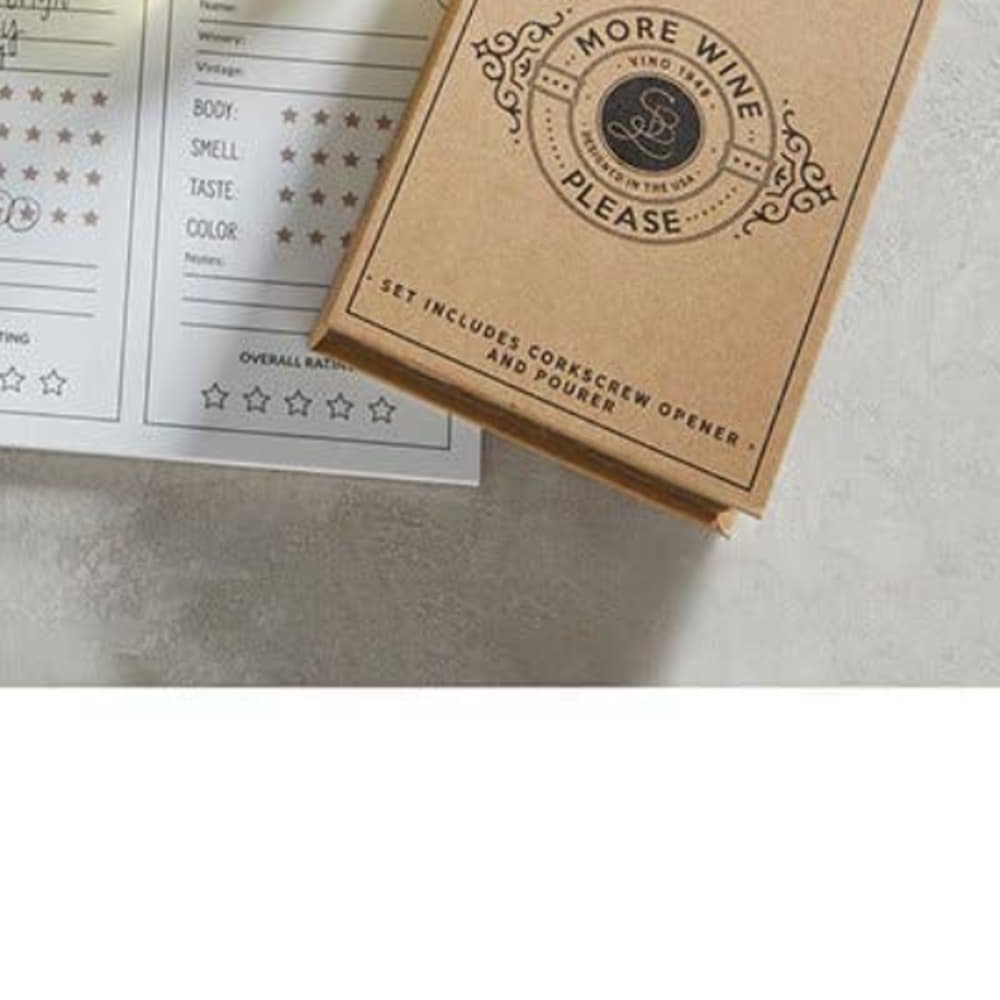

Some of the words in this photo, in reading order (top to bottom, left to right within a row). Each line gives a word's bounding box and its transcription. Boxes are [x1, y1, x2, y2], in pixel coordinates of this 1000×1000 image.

[576, 17, 679, 56] MORE
[696, 35, 763, 119] WINE
[627, 55, 671, 70] VINO
[561, 169, 681, 234] PLEASE
[625, 177, 639, 190] IN
[644, 181, 667, 193] THE
[239, 351, 301, 368] OVERALL
[380, 279, 416, 302] SET
[424, 299, 520, 349] INCLUDES
[528, 345, 651, 408] CORKSCREW
[658, 402, 739, 444] OPENER
[487, 348, 527, 374] AND
[534, 369, 616, 413] POURER
